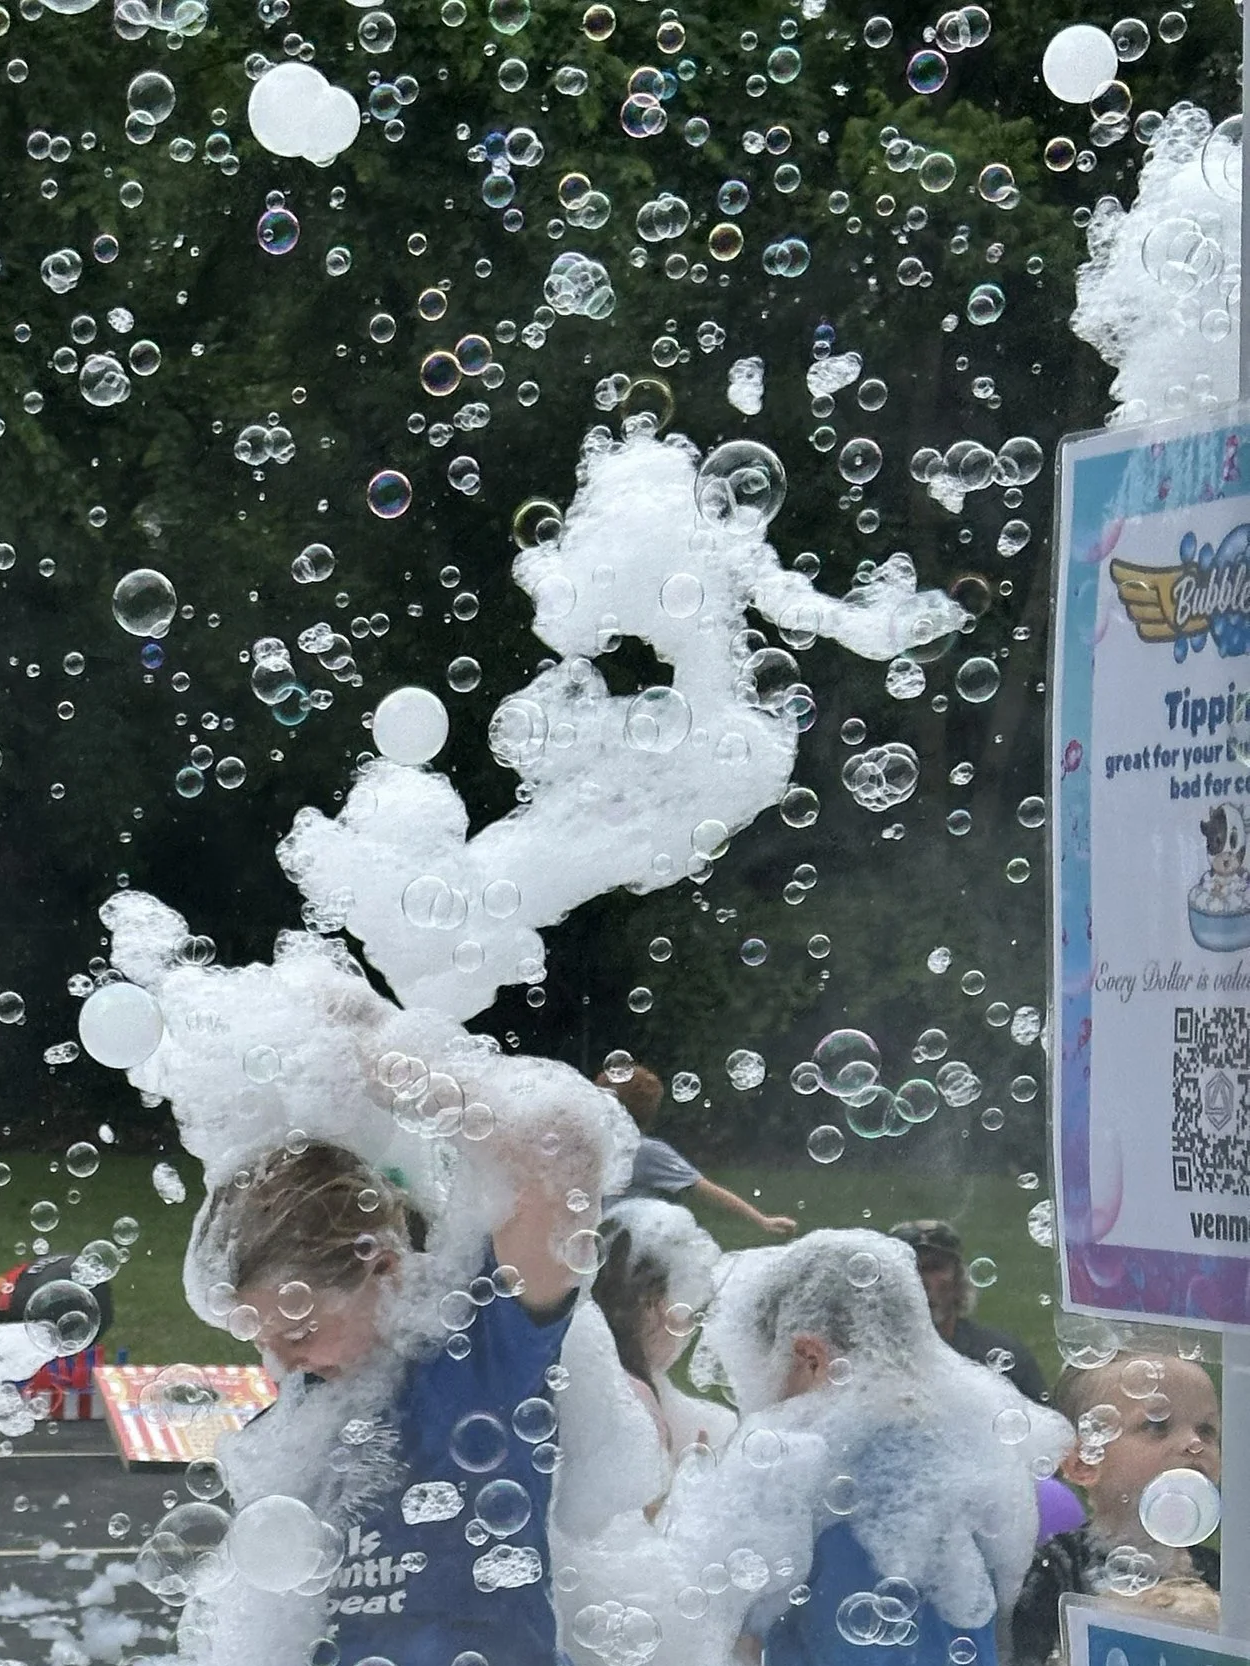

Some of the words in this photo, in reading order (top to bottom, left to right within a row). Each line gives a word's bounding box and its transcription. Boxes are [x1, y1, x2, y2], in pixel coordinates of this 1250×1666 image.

[1105, 745, 1150, 780] great
[1153, 743, 1180, 768] for
[1182, 744, 1223, 771] your
[1170, 775, 1201, 800] bad
[1204, 771, 1232, 797] for
[1095, 961, 1136, 1003] Every
[1143, 959, 1193, 992] Dollar
[1196, 967, 1209, 991] is
[1190, 1212, 1250, 1243] venm
